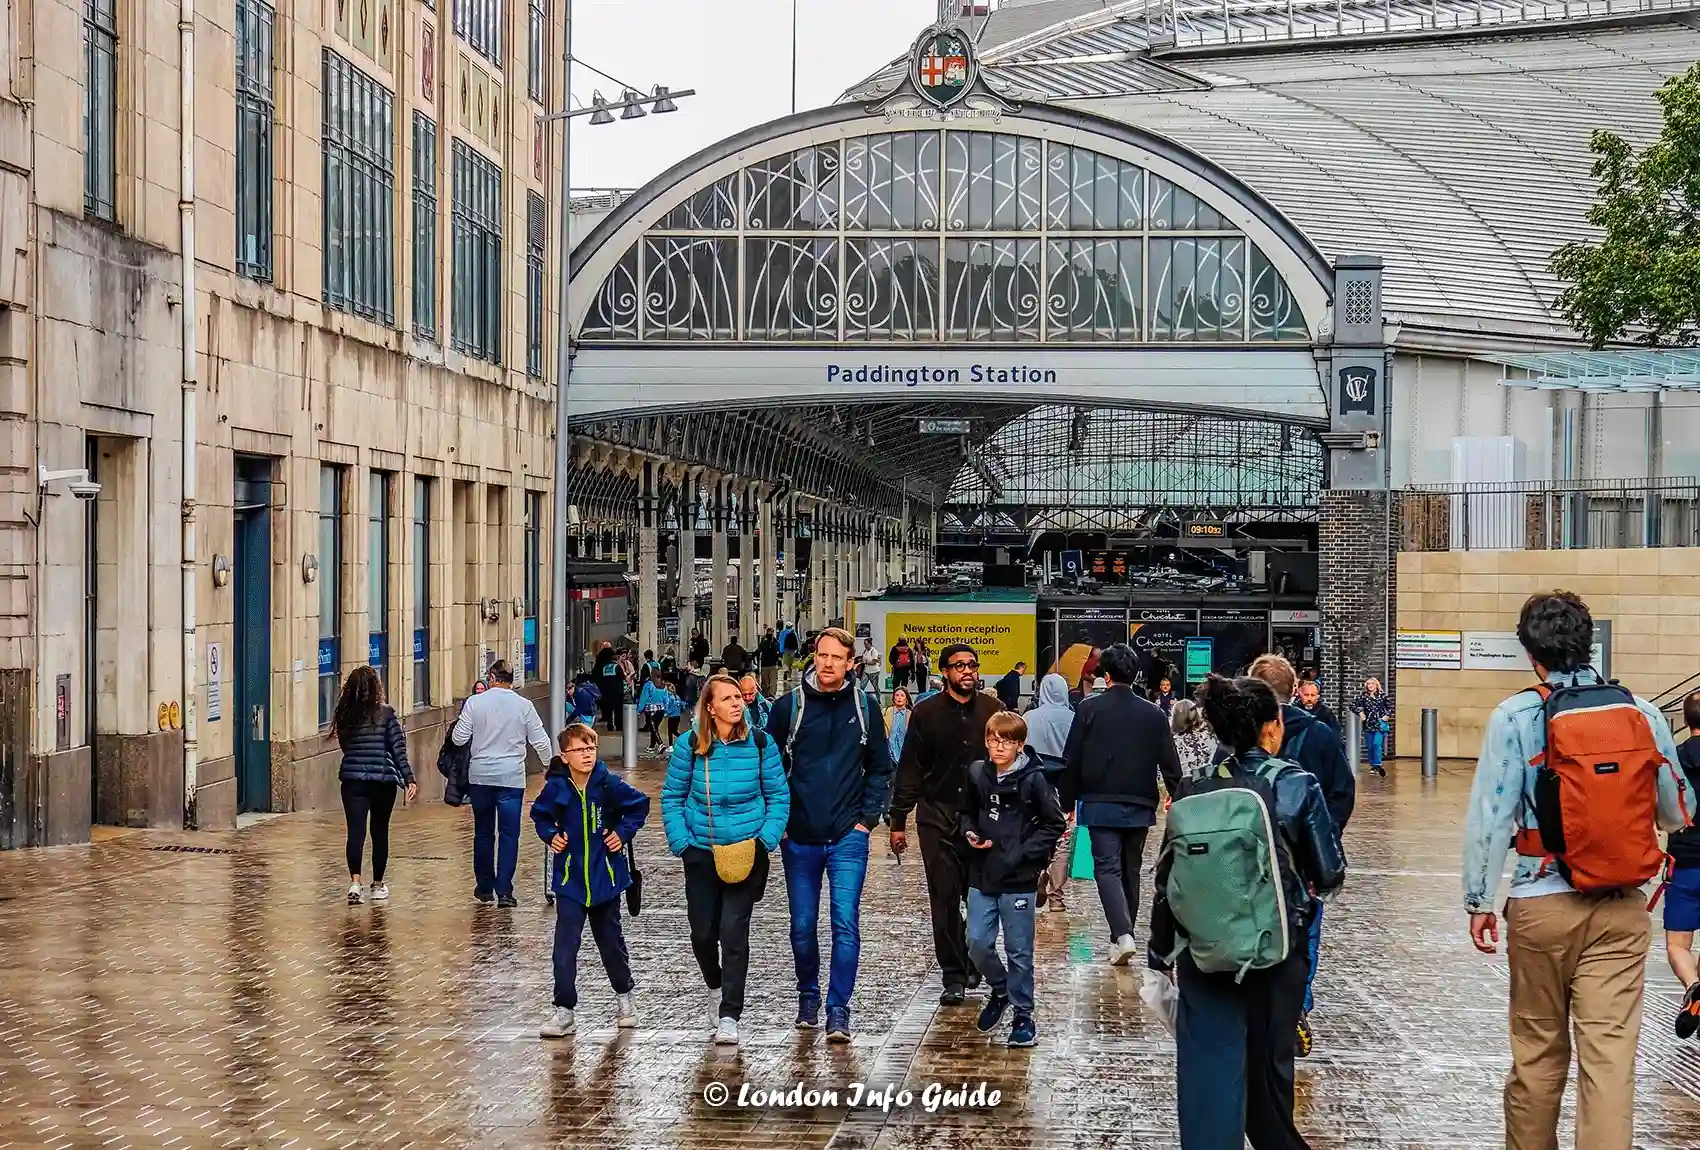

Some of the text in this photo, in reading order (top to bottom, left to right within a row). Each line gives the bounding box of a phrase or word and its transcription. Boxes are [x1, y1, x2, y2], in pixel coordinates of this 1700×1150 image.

[827, 364, 1057, 387] Paddington Station
[1067, 560, 1077, 573] 9
[903, 623, 1011, 635] New station reception
[933, 636, 995, 645] construction
[1136, 635, 1185, 647] Chocolat
